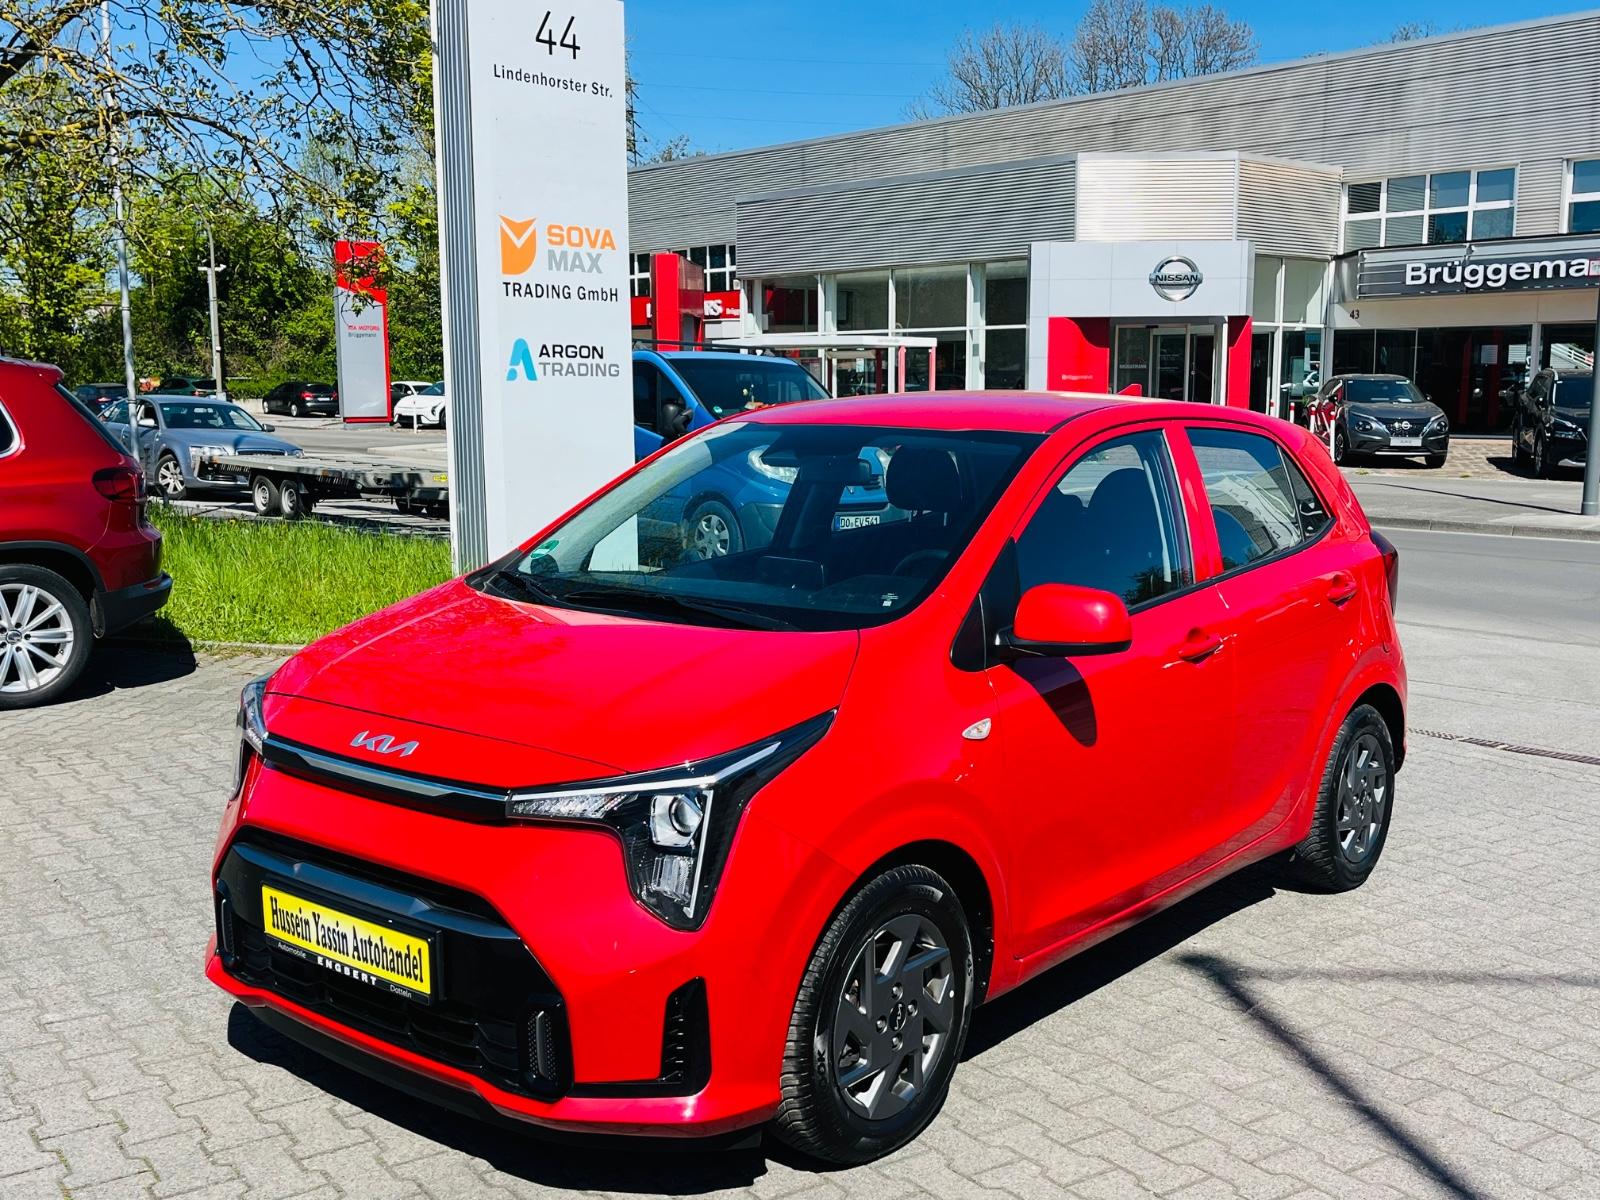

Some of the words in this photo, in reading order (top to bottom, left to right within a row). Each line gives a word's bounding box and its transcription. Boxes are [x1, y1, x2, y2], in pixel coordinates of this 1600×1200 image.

[535, 10, 581, 60] 44
[493, 63, 587, 93] Lindenhorster
[591, 81, 613, 98] Str.
[546, 224, 616, 250] SOVA
[547, 249, 602, 273] MAX
[1405, 258, 1591, 289] Brüggema
[1155, 274, 1198, 282] NISSAN
[503, 281, 571, 299] TRADING
[577, 286, 618, 302] GmbH
[1349, 309, 1360, 320] 43
[538, 344, 604, 359] ARGON
[538, 362, 620, 377] TRADING
[350, 730, 419, 757] KIA
[269, 896, 312, 943] Hussein
[312, 911, 350, 955] Yassin
[351, 925, 424, 983] Autohandel
[277, 942, 307, 959] Automobile
[317, 955, 377, 986] ENGBERT
